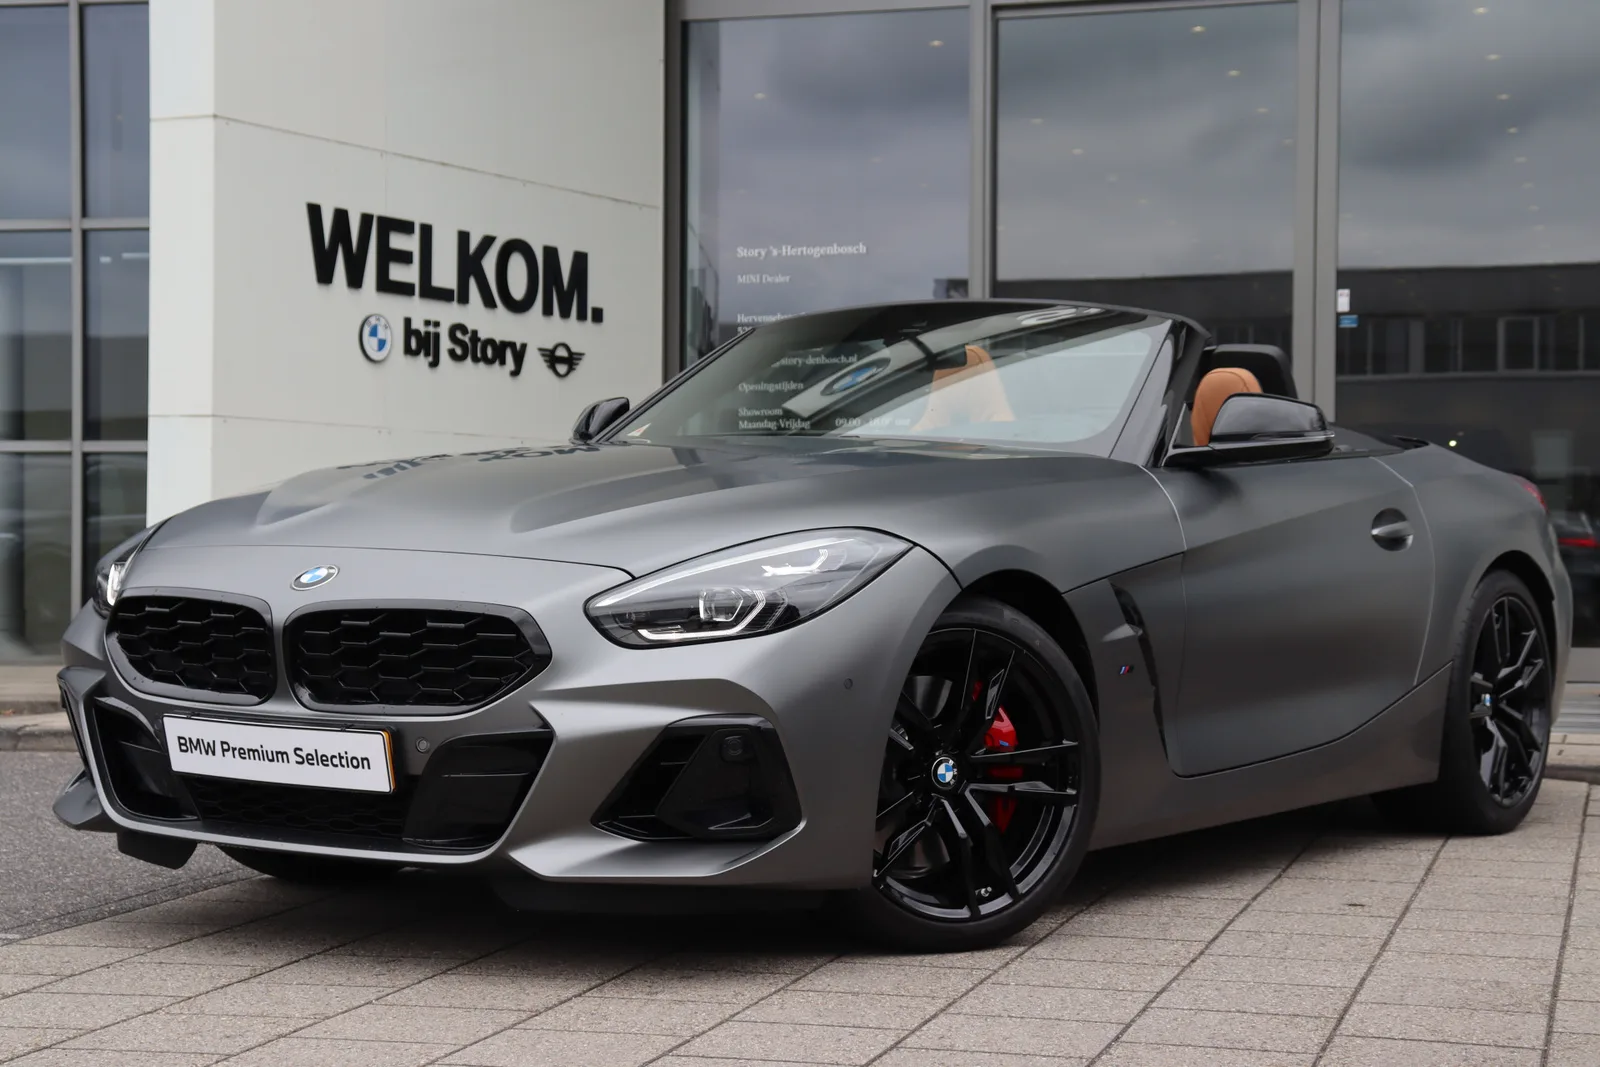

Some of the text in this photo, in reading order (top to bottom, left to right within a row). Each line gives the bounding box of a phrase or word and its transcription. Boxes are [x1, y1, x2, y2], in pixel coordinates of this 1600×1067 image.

[737, 246, 767, 260] Story
[306, 202, 603, 323] WELKOM.
[737, 273, 790, 283] MINI Dealer
[403, 317, 527, 377] bij Story
[738, 381, 804, 393] Openingstijden
[738, 407, 783, 416] Showroom
[177, 736, 371, 770] BMW Premium Selection
